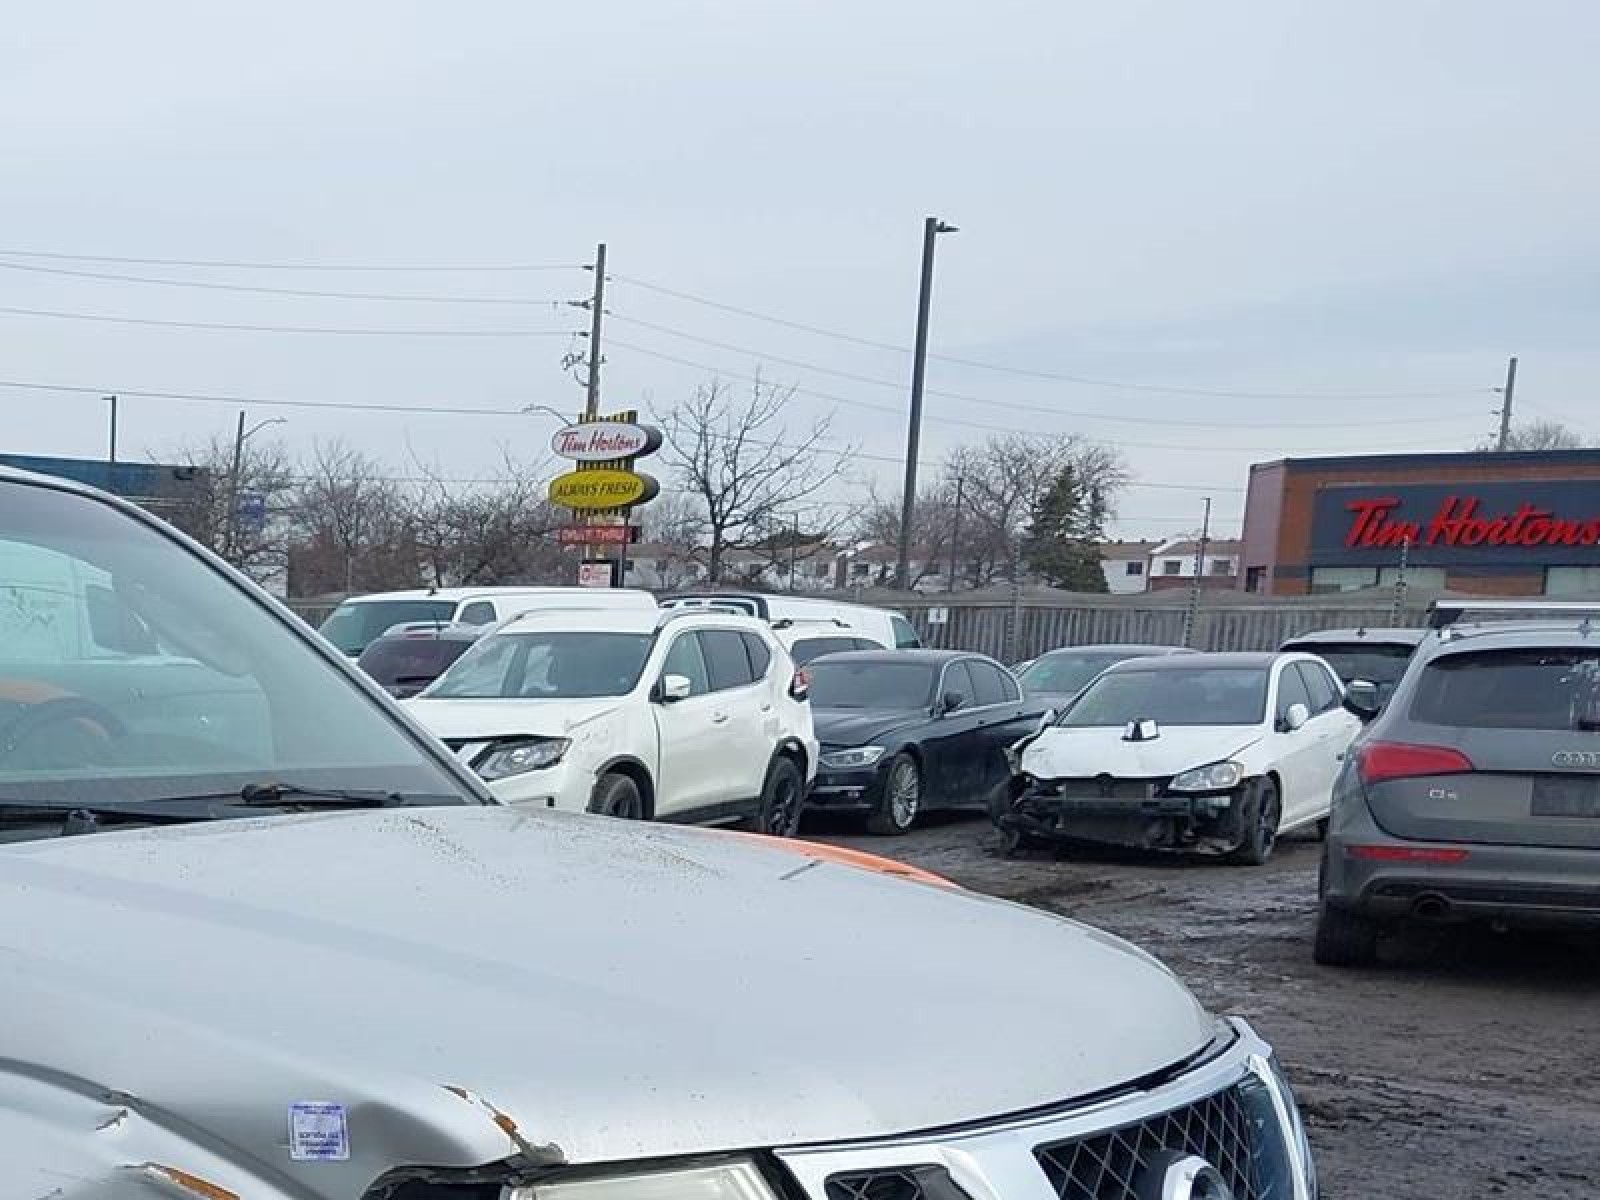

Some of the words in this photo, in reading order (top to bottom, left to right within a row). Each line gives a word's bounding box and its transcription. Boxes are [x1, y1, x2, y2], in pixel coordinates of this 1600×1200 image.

[561, 431, 587, 452] Tim
[588, 428, 641, 451] Hortons
[557, 482, 598, 497] ALWAYS
[599, 481, 640, 496] FRESH
[1344, 496, 1422, 548] Tim
[1426, 495, 1600, 547] Hortons
